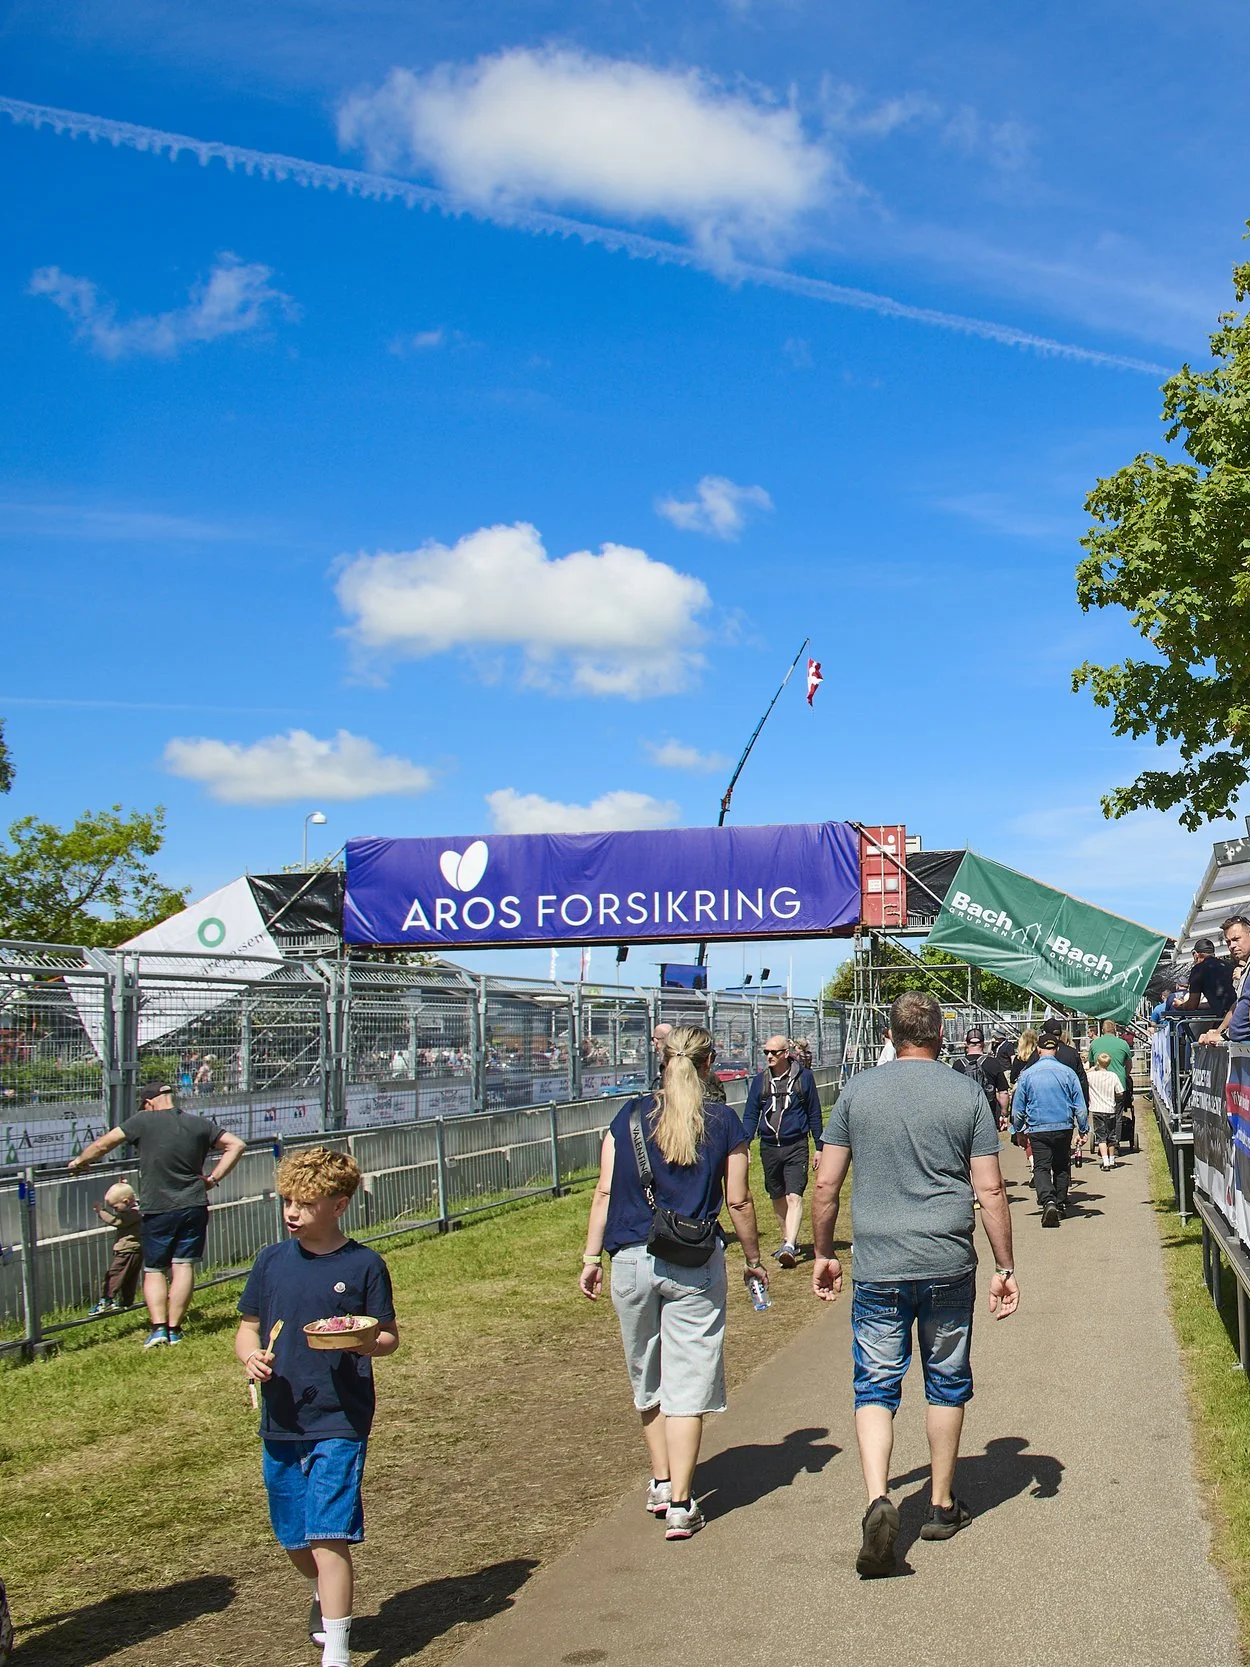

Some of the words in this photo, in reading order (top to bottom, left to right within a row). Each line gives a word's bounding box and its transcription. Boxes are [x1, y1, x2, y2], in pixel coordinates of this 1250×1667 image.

[401, 895, 521, 932] AROS
[537, 886, 801, 927] FORSIKRING
[949, 907, 1008, 937] GRUPPEN
[951, 891, 1013, 931] Bach
[1050, 952, 1109, 981] GRUPPEN
[1052, 935, 1114, 975] Bach
